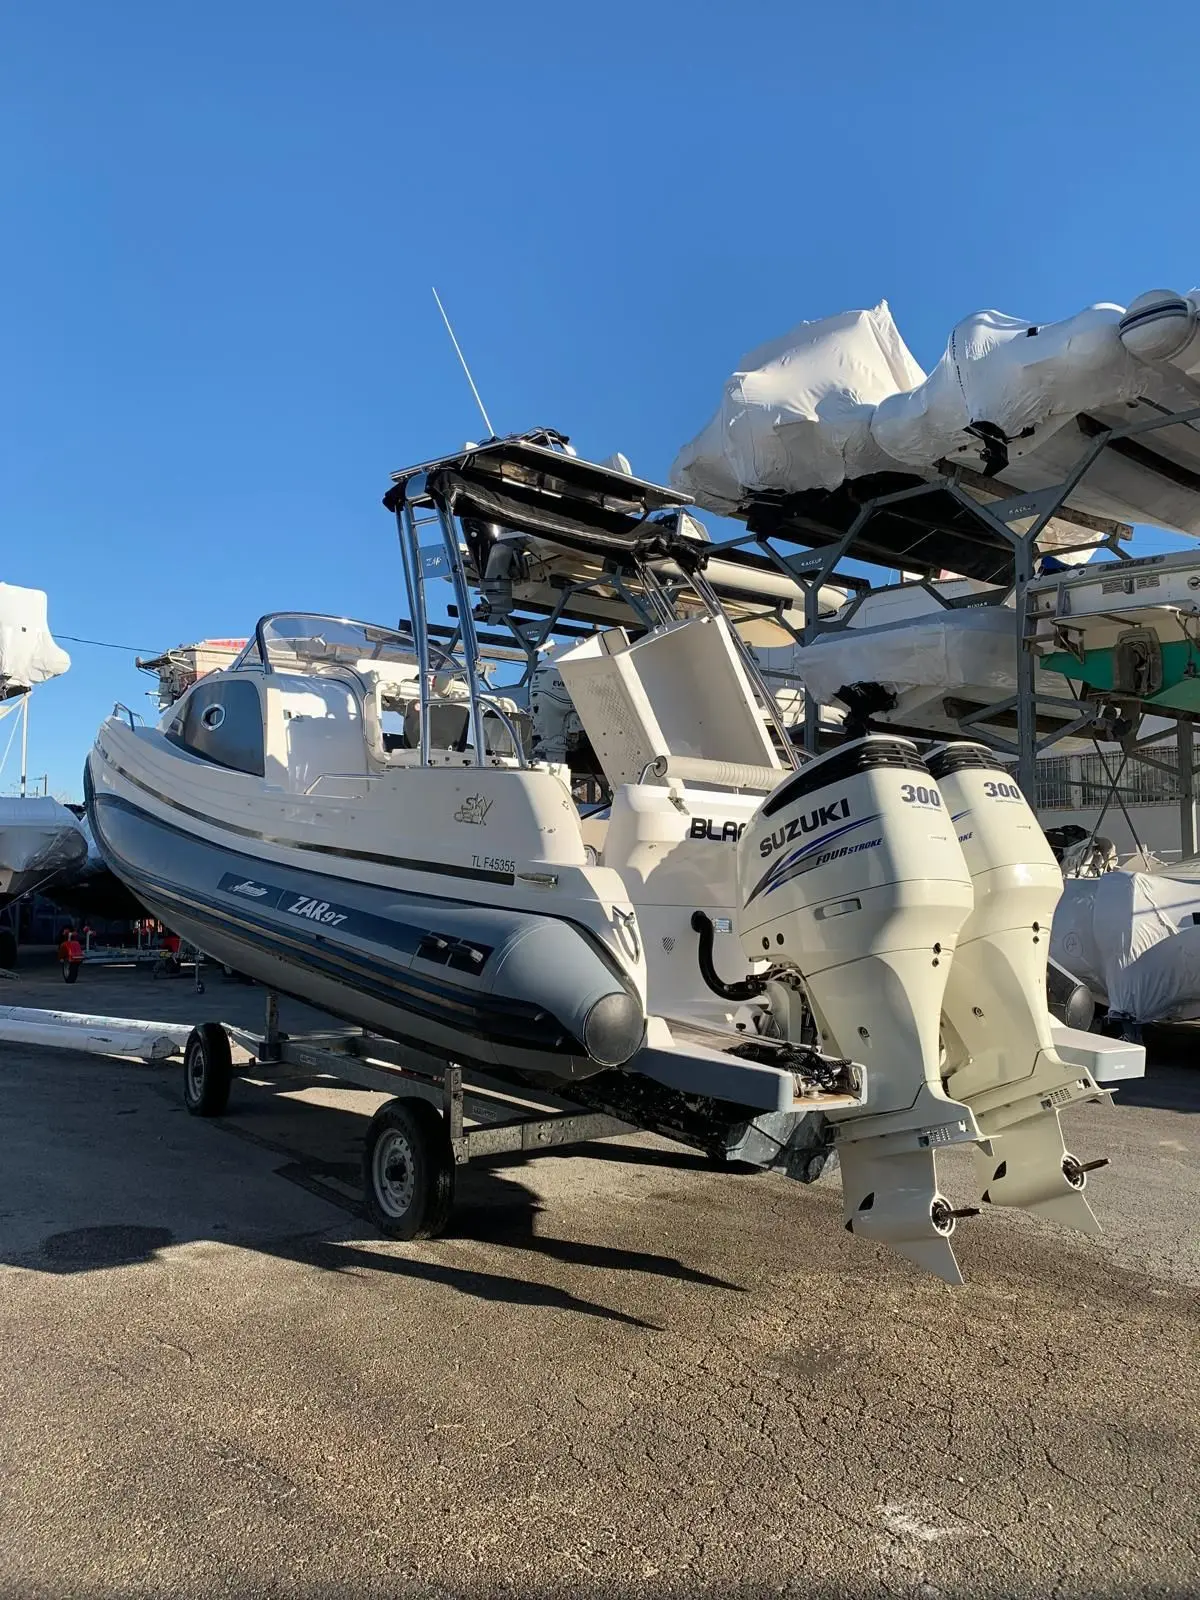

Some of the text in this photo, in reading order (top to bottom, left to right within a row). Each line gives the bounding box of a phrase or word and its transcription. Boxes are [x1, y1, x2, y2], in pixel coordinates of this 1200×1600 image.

[901, 784, 941, 807] 300
[983, 781, 1021, 800] 300
[759, 798, 851, 858] SUZUKI
[471, 855, 516, 873] TL F45355
